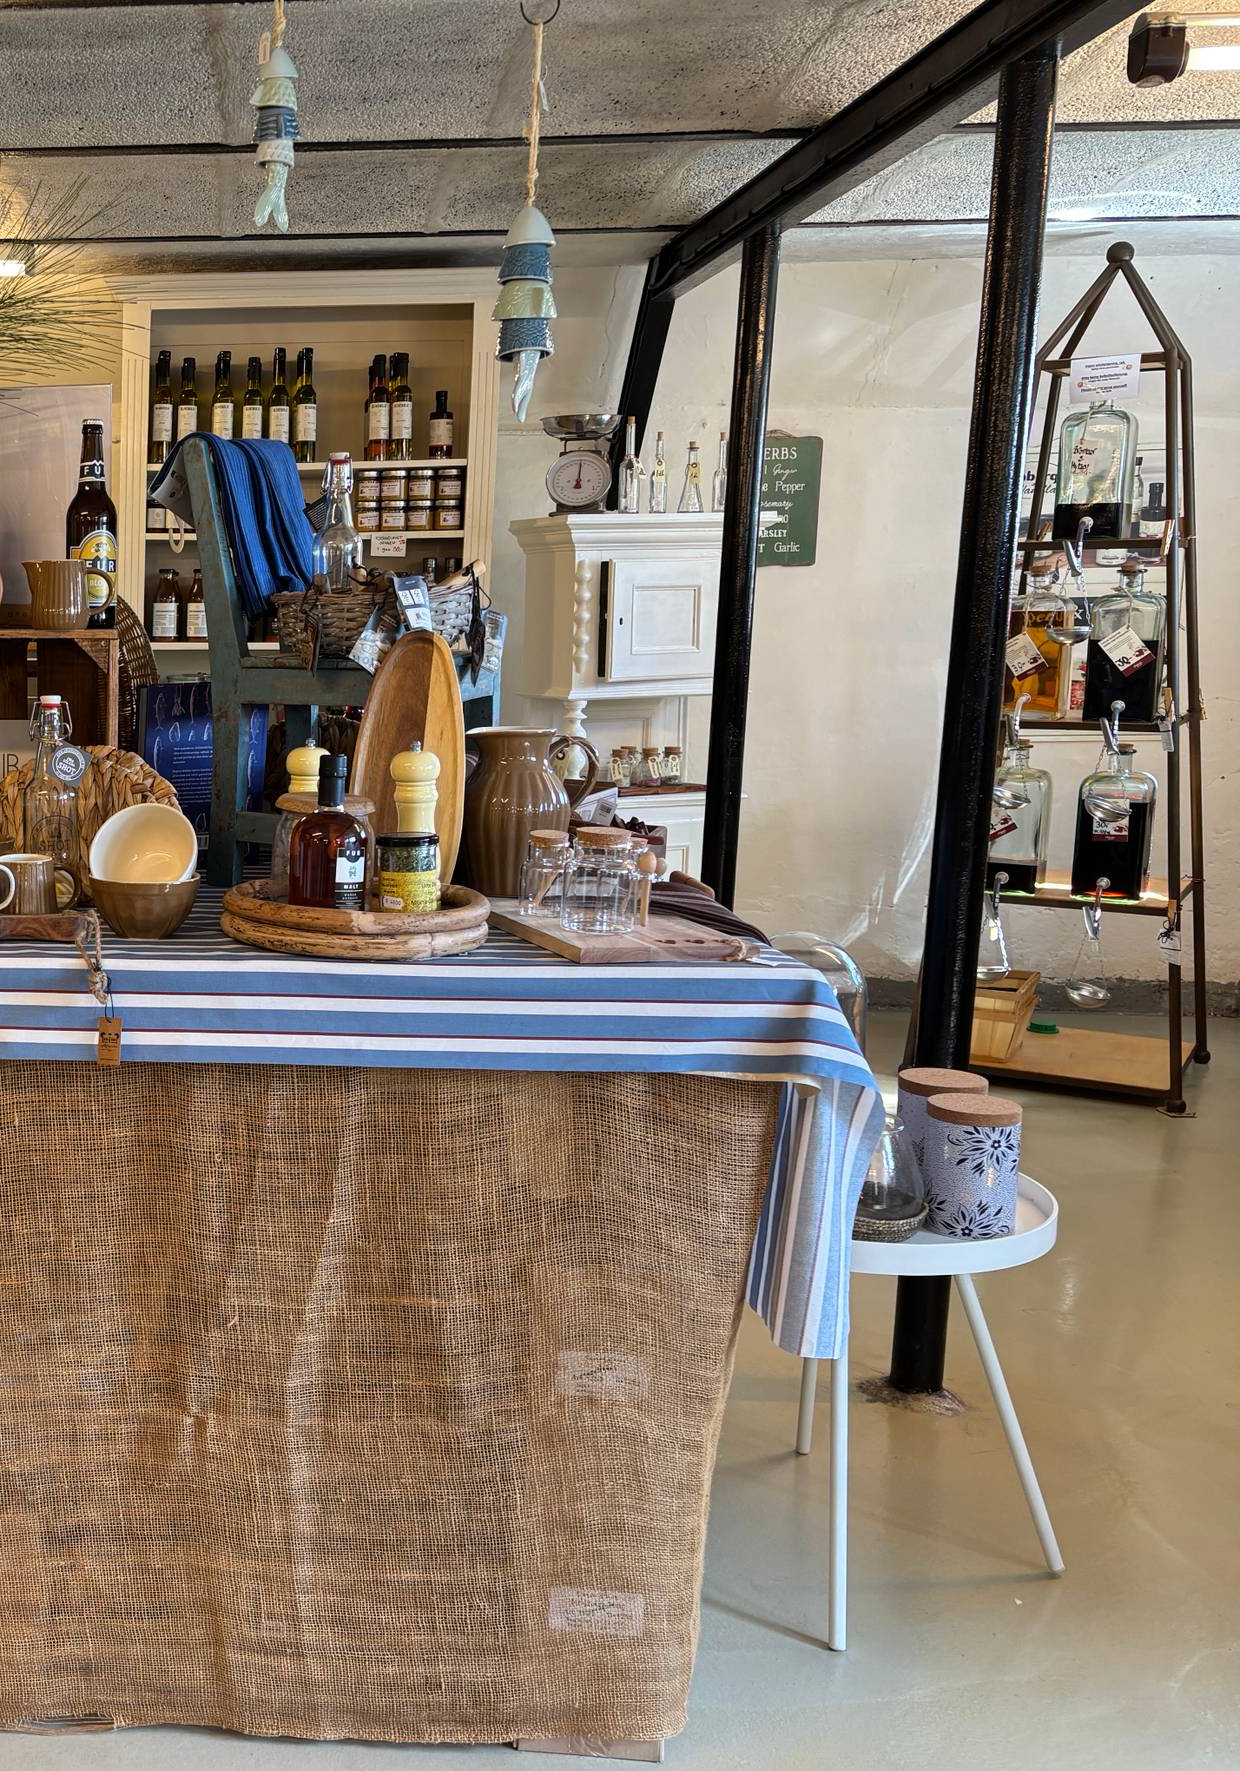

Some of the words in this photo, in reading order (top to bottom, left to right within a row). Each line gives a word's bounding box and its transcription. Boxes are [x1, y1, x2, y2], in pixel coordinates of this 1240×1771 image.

[763, 447, 798, 461] ERBS
[775, 481, 806, 495] Pepper
[758, 529, 788, 538] ARSLEY
[773, 542, 801, 553] Garlic
[57, 762, 77, 775] SHOT
